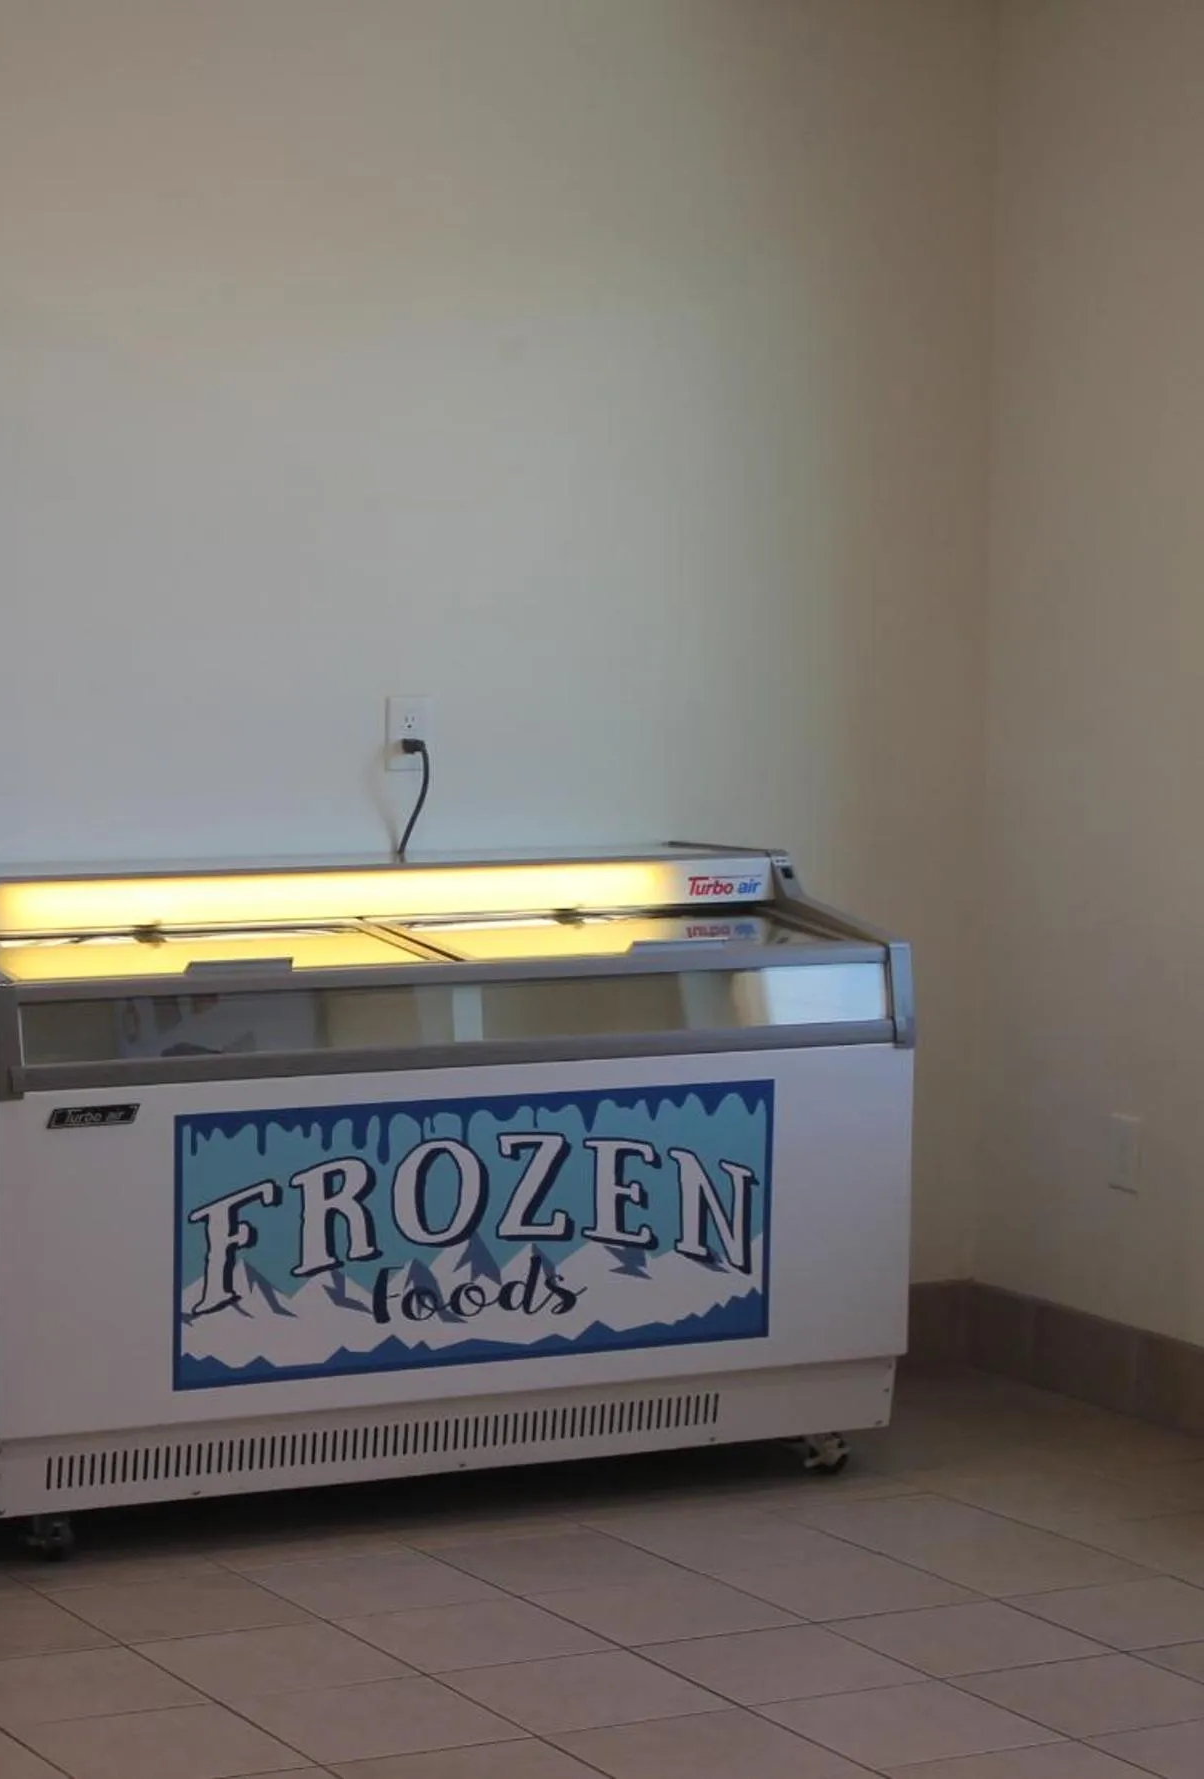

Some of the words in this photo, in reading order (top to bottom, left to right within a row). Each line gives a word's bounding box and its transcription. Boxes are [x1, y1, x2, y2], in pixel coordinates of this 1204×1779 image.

[688, 876, 734, 896] Turbo
[738, 878, 762, 894] air
[191, 1130, 760, 1316] FROZEN
